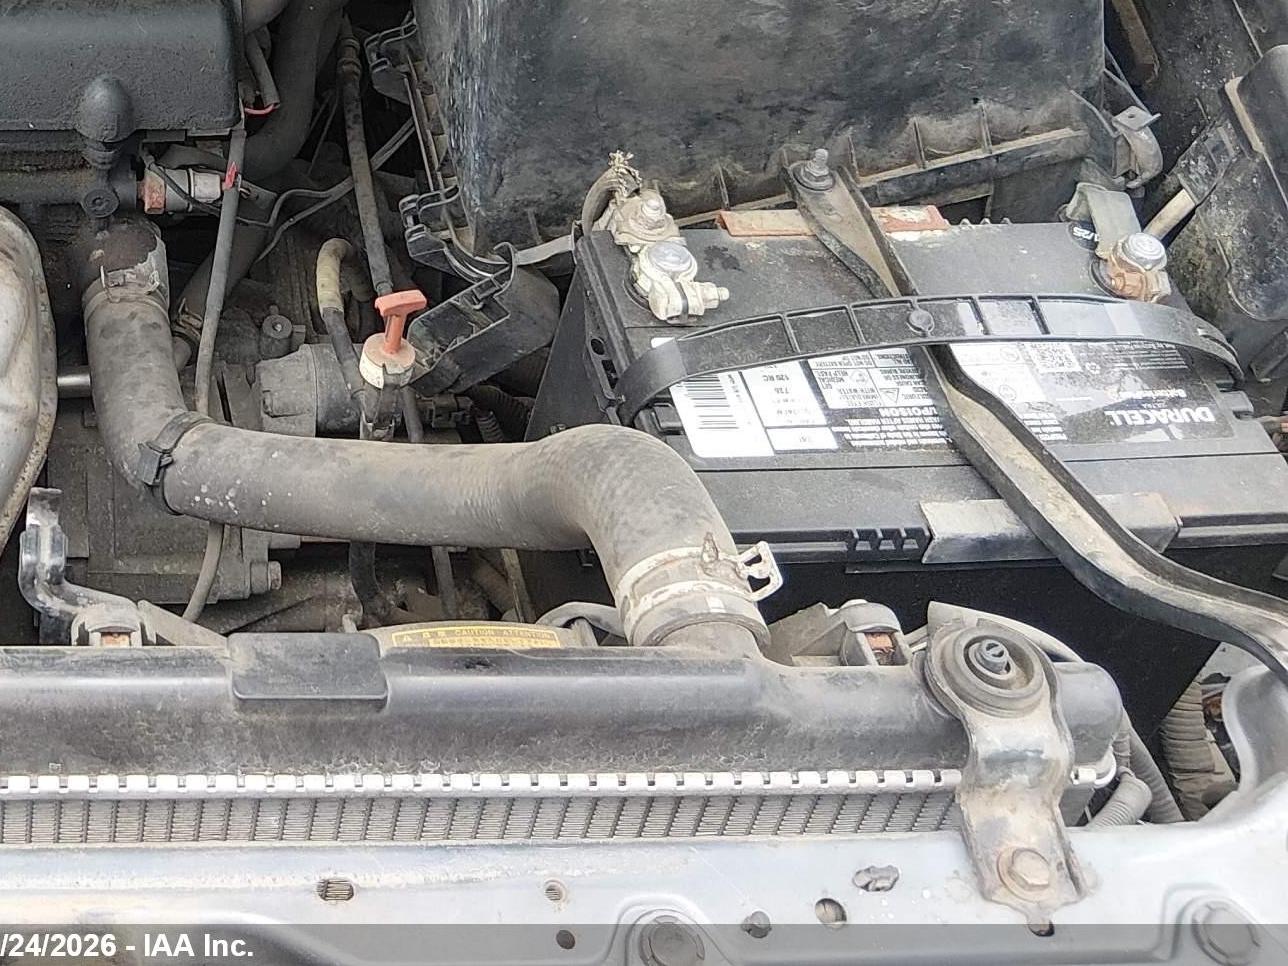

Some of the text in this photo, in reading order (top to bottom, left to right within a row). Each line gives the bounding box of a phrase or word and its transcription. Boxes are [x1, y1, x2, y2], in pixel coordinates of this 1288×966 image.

[1104, 406, 1216, 426] DURACELL
[454, 629, 551, 639] CAUTION ATTENTION
